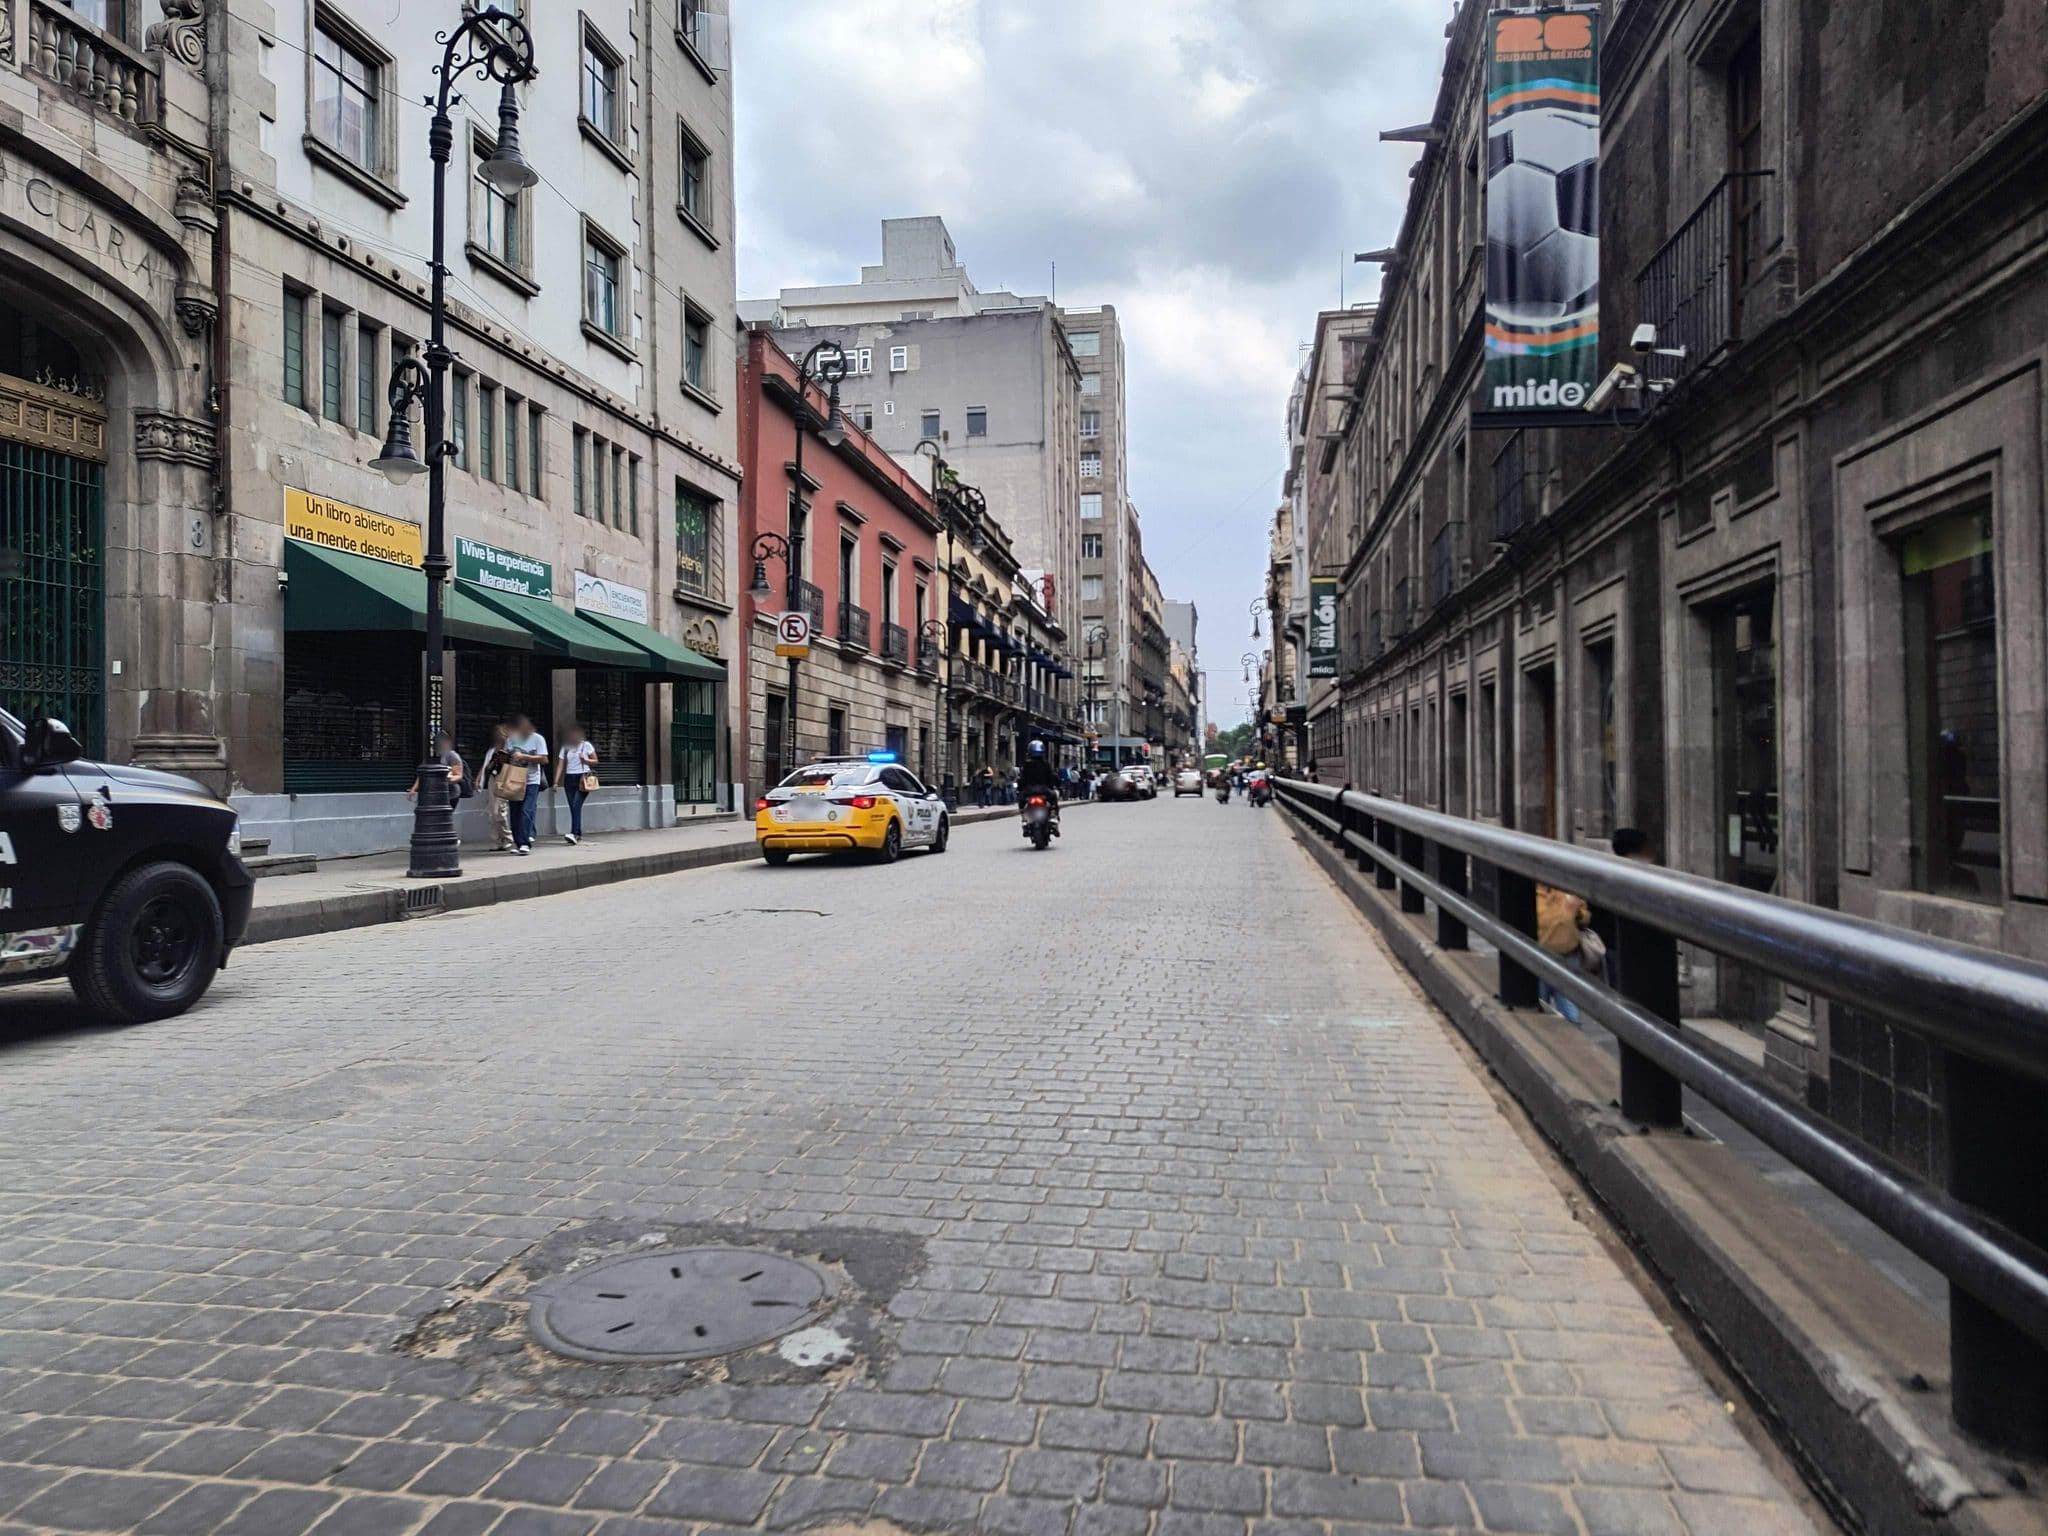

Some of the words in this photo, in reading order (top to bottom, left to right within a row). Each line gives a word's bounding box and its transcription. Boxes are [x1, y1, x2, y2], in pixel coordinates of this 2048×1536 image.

[1496, 53, 1535, 62] CIUDAD
[1536, 51, 1550, 61] DE
[26, 178, 153, 289] CLARA
[306, 496, 323, 516] Un
[326, 502, 352, 524] libro
[354, 513, 395, 536] abierto
[290, 523, 313, 540] una
[317, 530, 357, 551] mente
[360, 540, 413, 566] despierta
[486, 546, 496, 563] la
[496, 553, 545, 577] experiencia
[479, 568, 529, 595] Maranatha!
[611, 590, 642, 607] ENCUENTROS
[611, 600, 622, 610] CON
[786, 619, 801, 638] E
[1314, 595, 1336, 648] BALÓN
